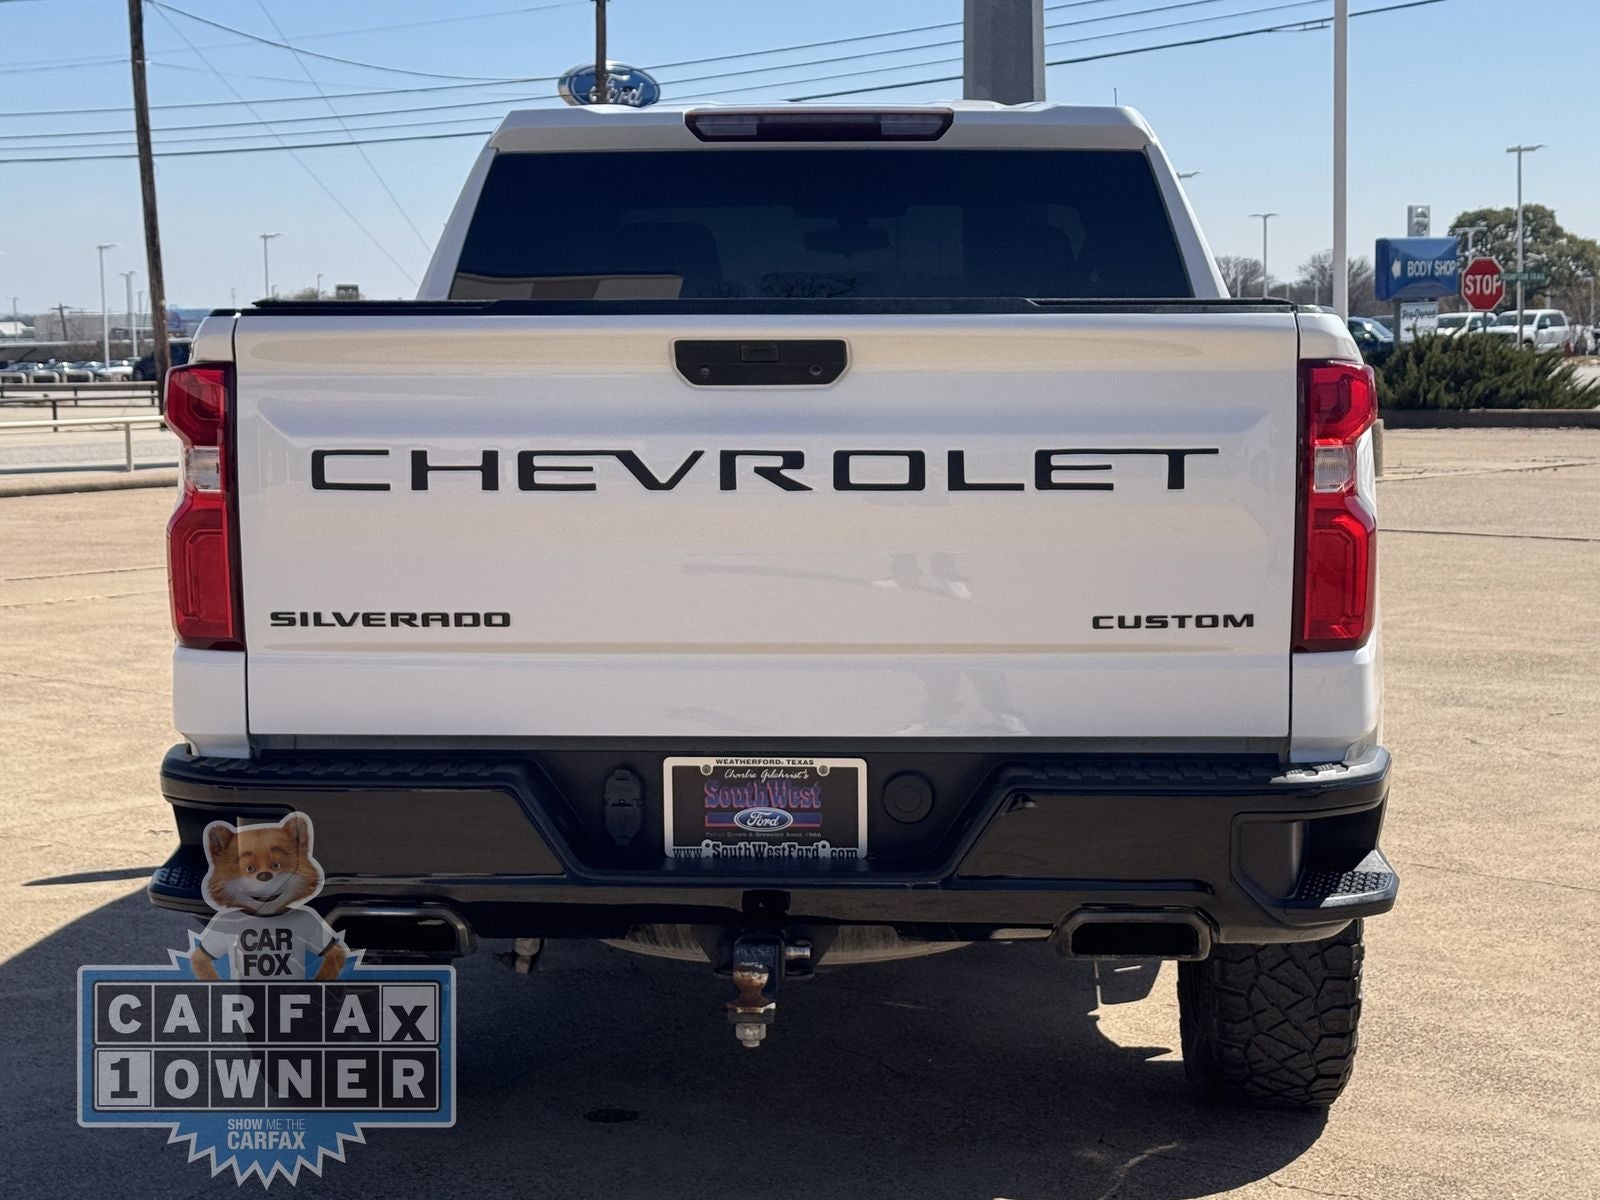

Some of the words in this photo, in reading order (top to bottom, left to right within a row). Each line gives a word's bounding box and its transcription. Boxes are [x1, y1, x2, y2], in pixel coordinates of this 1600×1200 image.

[1407, 260, 1433, 277] BODY
[1434, 259, 1456, 276] SHOP
[1464, 274, 1502, 295] STOP
[311, 447, 1219, 491] CHEVROLET
[270, 610, 511, 628] SILVERADO
[1092, 613, 1255, 630] CUSTOM
[724, 768, 758, 779] Charlie
[760, 768, 809, 782] Gilchrist's
[704, 779, 821, 808] SouthWest
[746, 811, 779, 826] Ford
